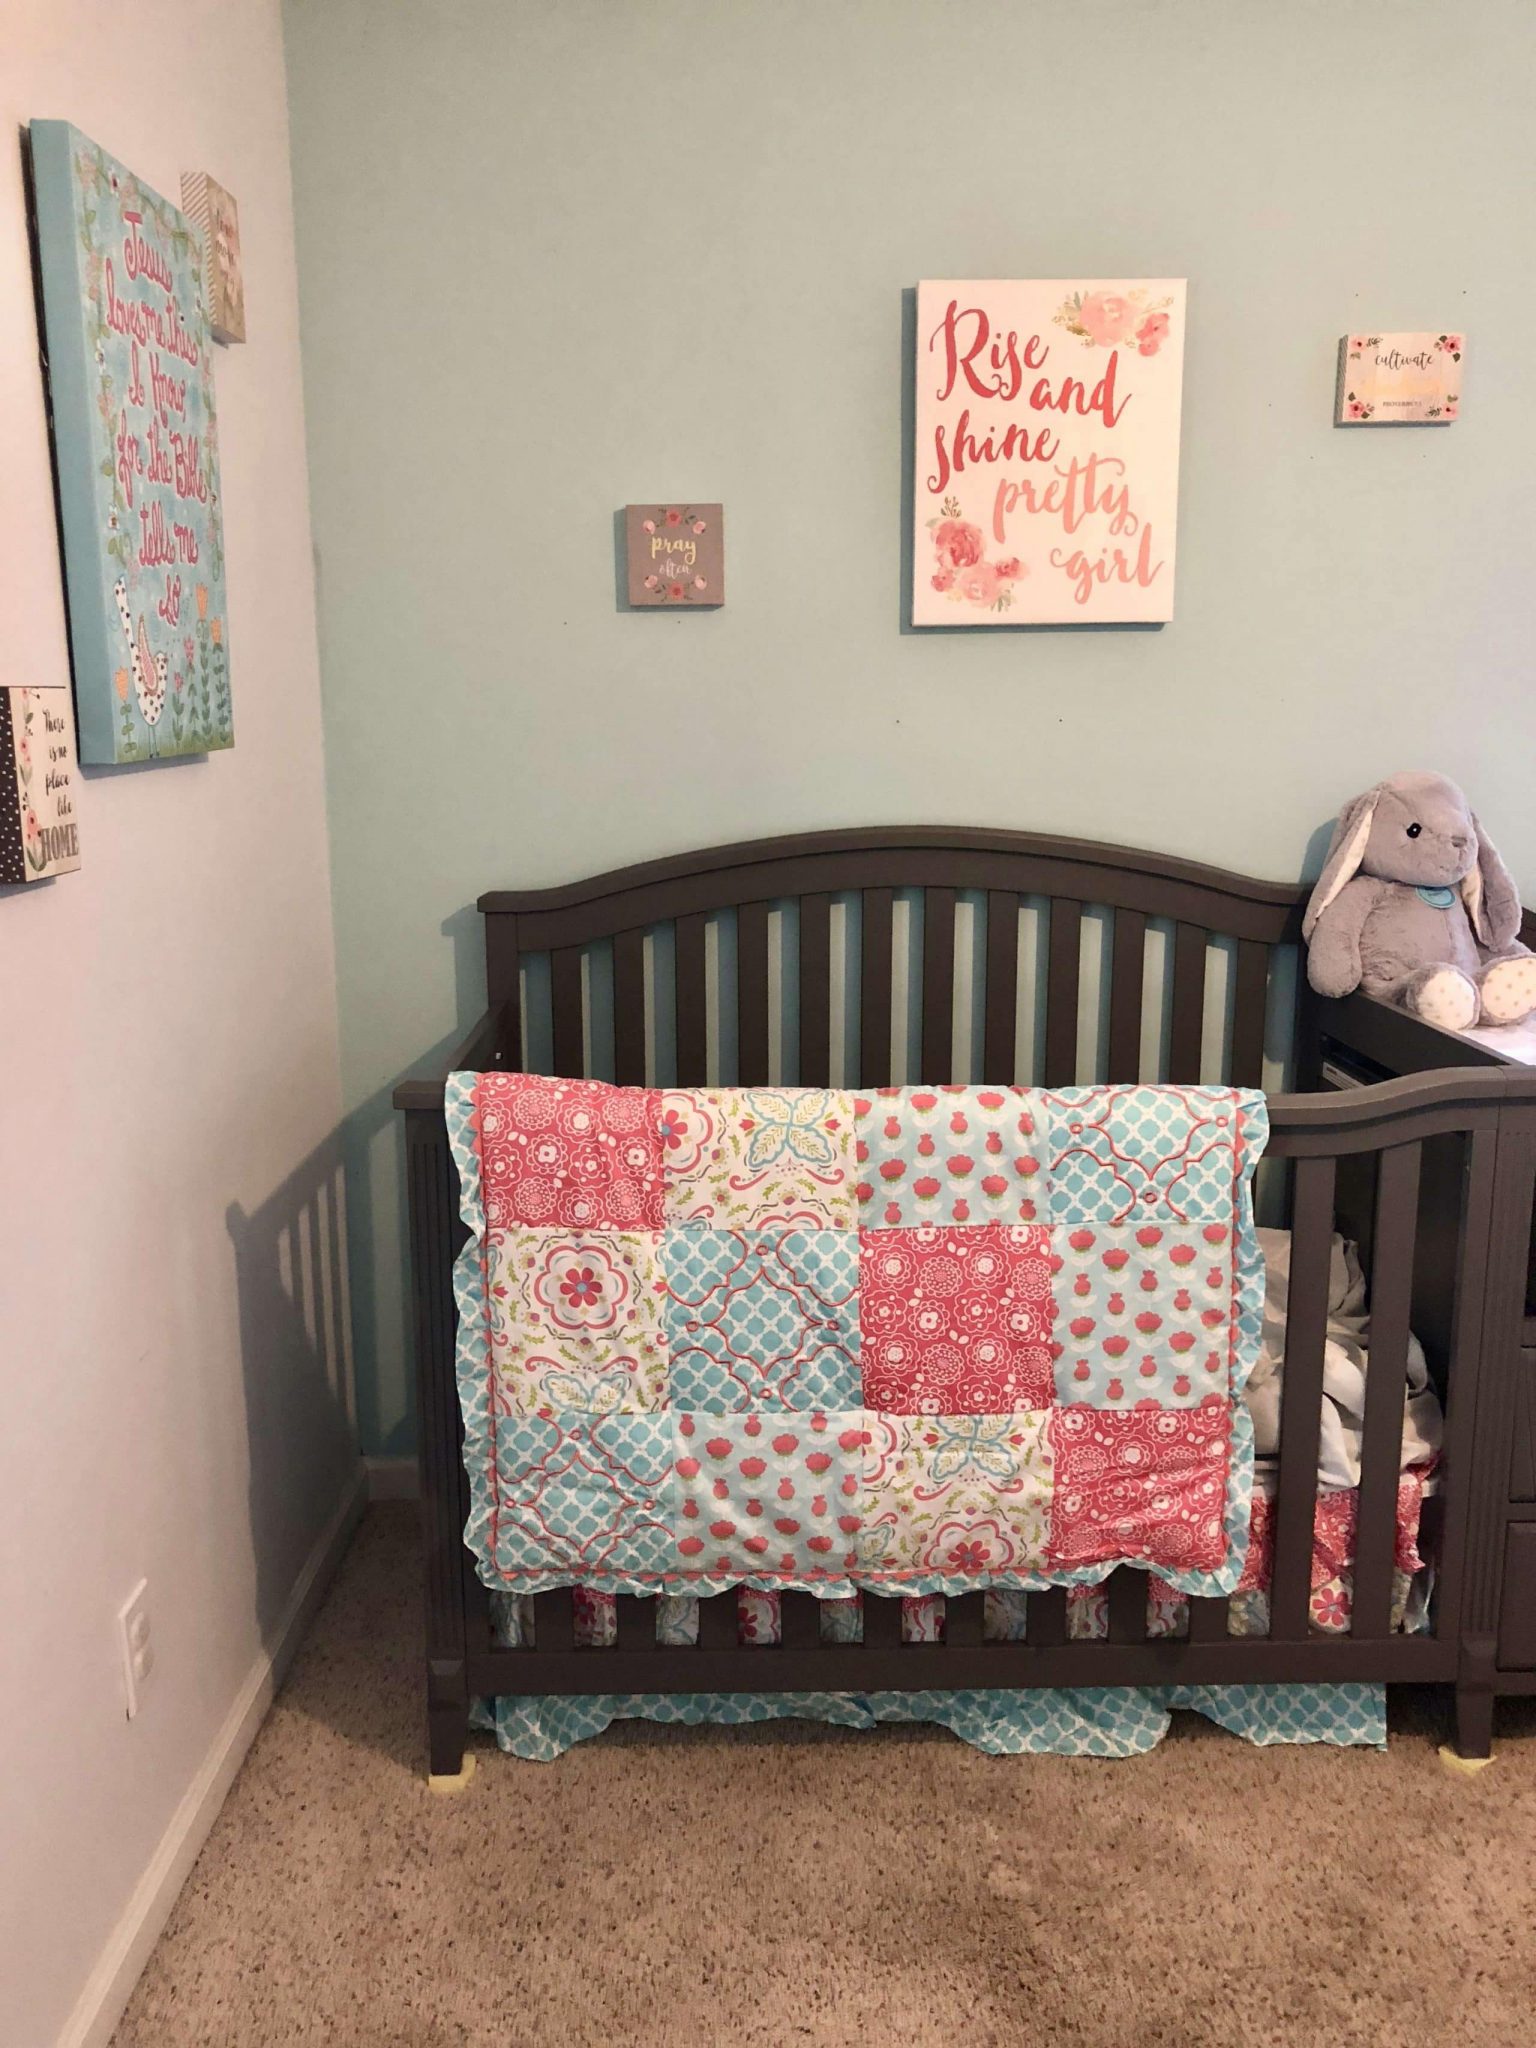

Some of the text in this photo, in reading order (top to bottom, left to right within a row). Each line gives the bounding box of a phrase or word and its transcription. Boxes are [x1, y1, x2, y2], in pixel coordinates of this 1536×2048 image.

[930, 300, 1049, 401] Rise
[1375, 349, 1434, 370] cultivate
[1030, 351, 1132, 428] and
[117, 409, 143, 509] for
[147, 416, 172, 483] the
[993, 453, 1138, 544] pretty
[139, 501, 198, 566] tells me
[651, 536, 697, 565] pray
[659, 558, 691, 579] often
[1050, 523, 1165, 605] girl
[43, 709, 65, 733] There
[45, 768, 70, 796] place
[57, 794, 72, 817] like
[41, 823, 79, 862] HOME
